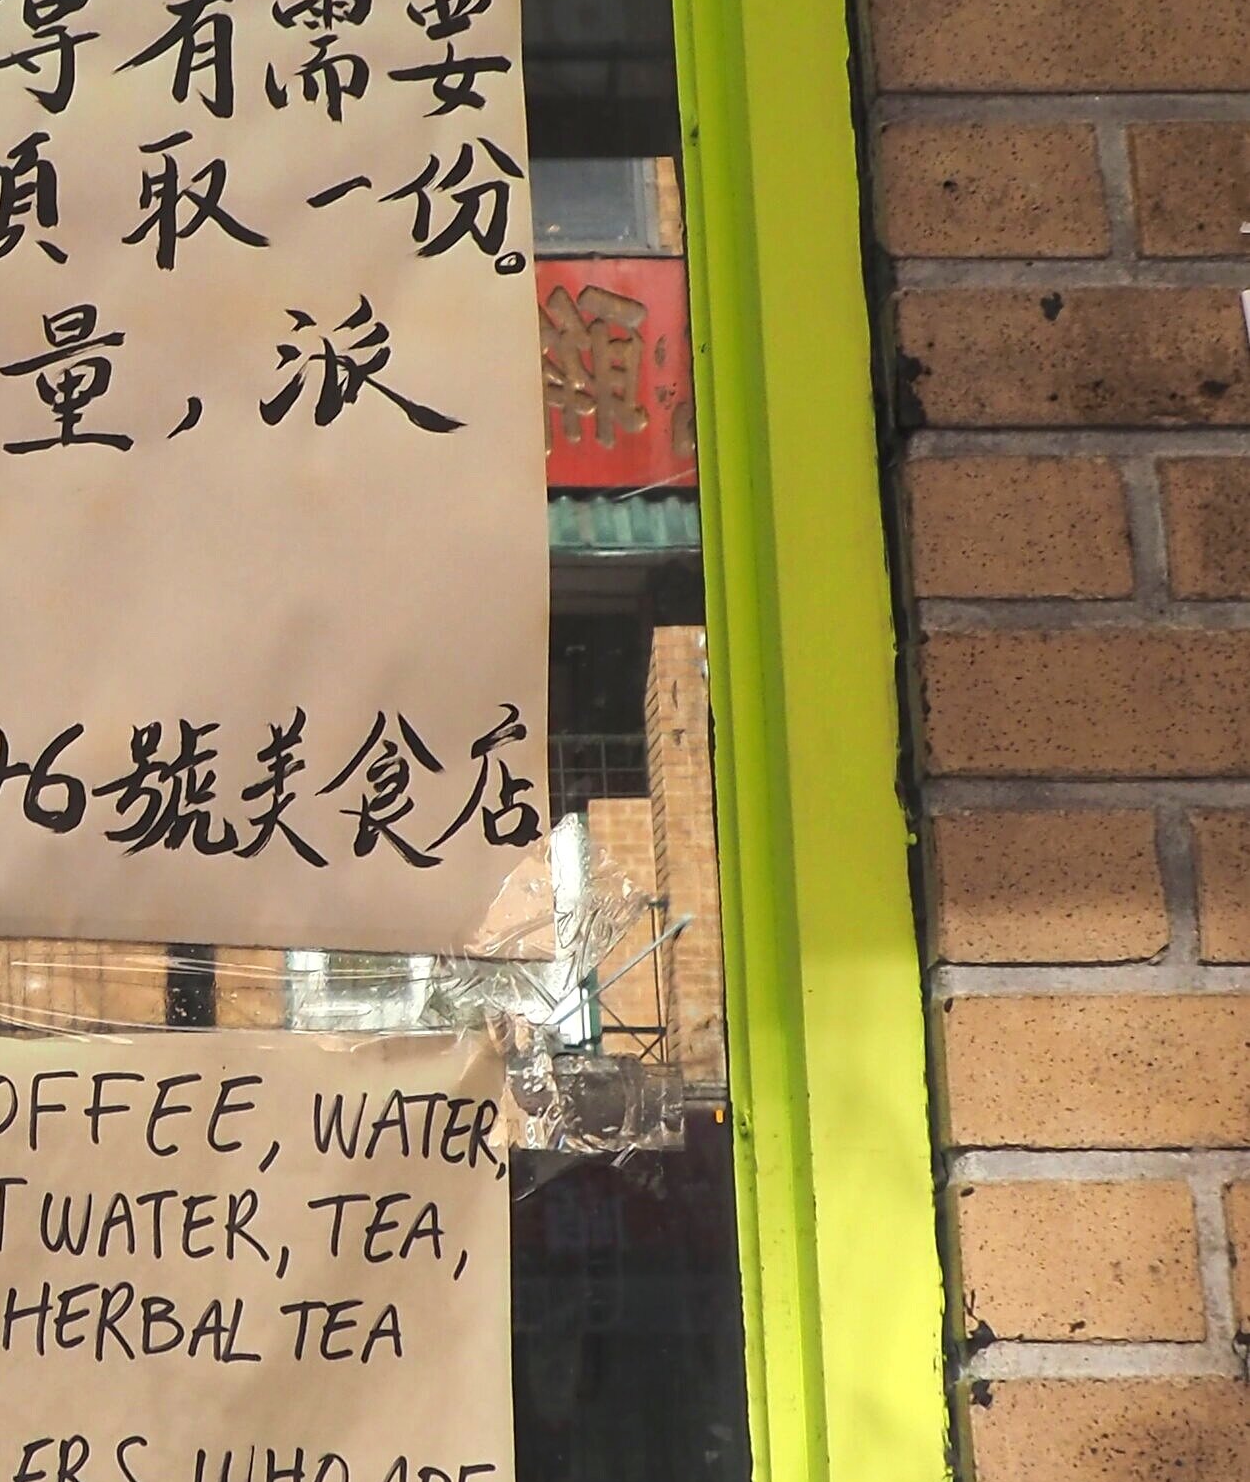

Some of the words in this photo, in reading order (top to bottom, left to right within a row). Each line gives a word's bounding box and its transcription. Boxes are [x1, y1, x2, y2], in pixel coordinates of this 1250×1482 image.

[314, 1090, 506, 1179] WATER,
[41, 1189, 289, 1278] WATER,
[308, 1193, 467, 1280] TEA,
[3, 1282, 261, 1363] HERBAL
[280, 1300, 402, 1363] TEA
